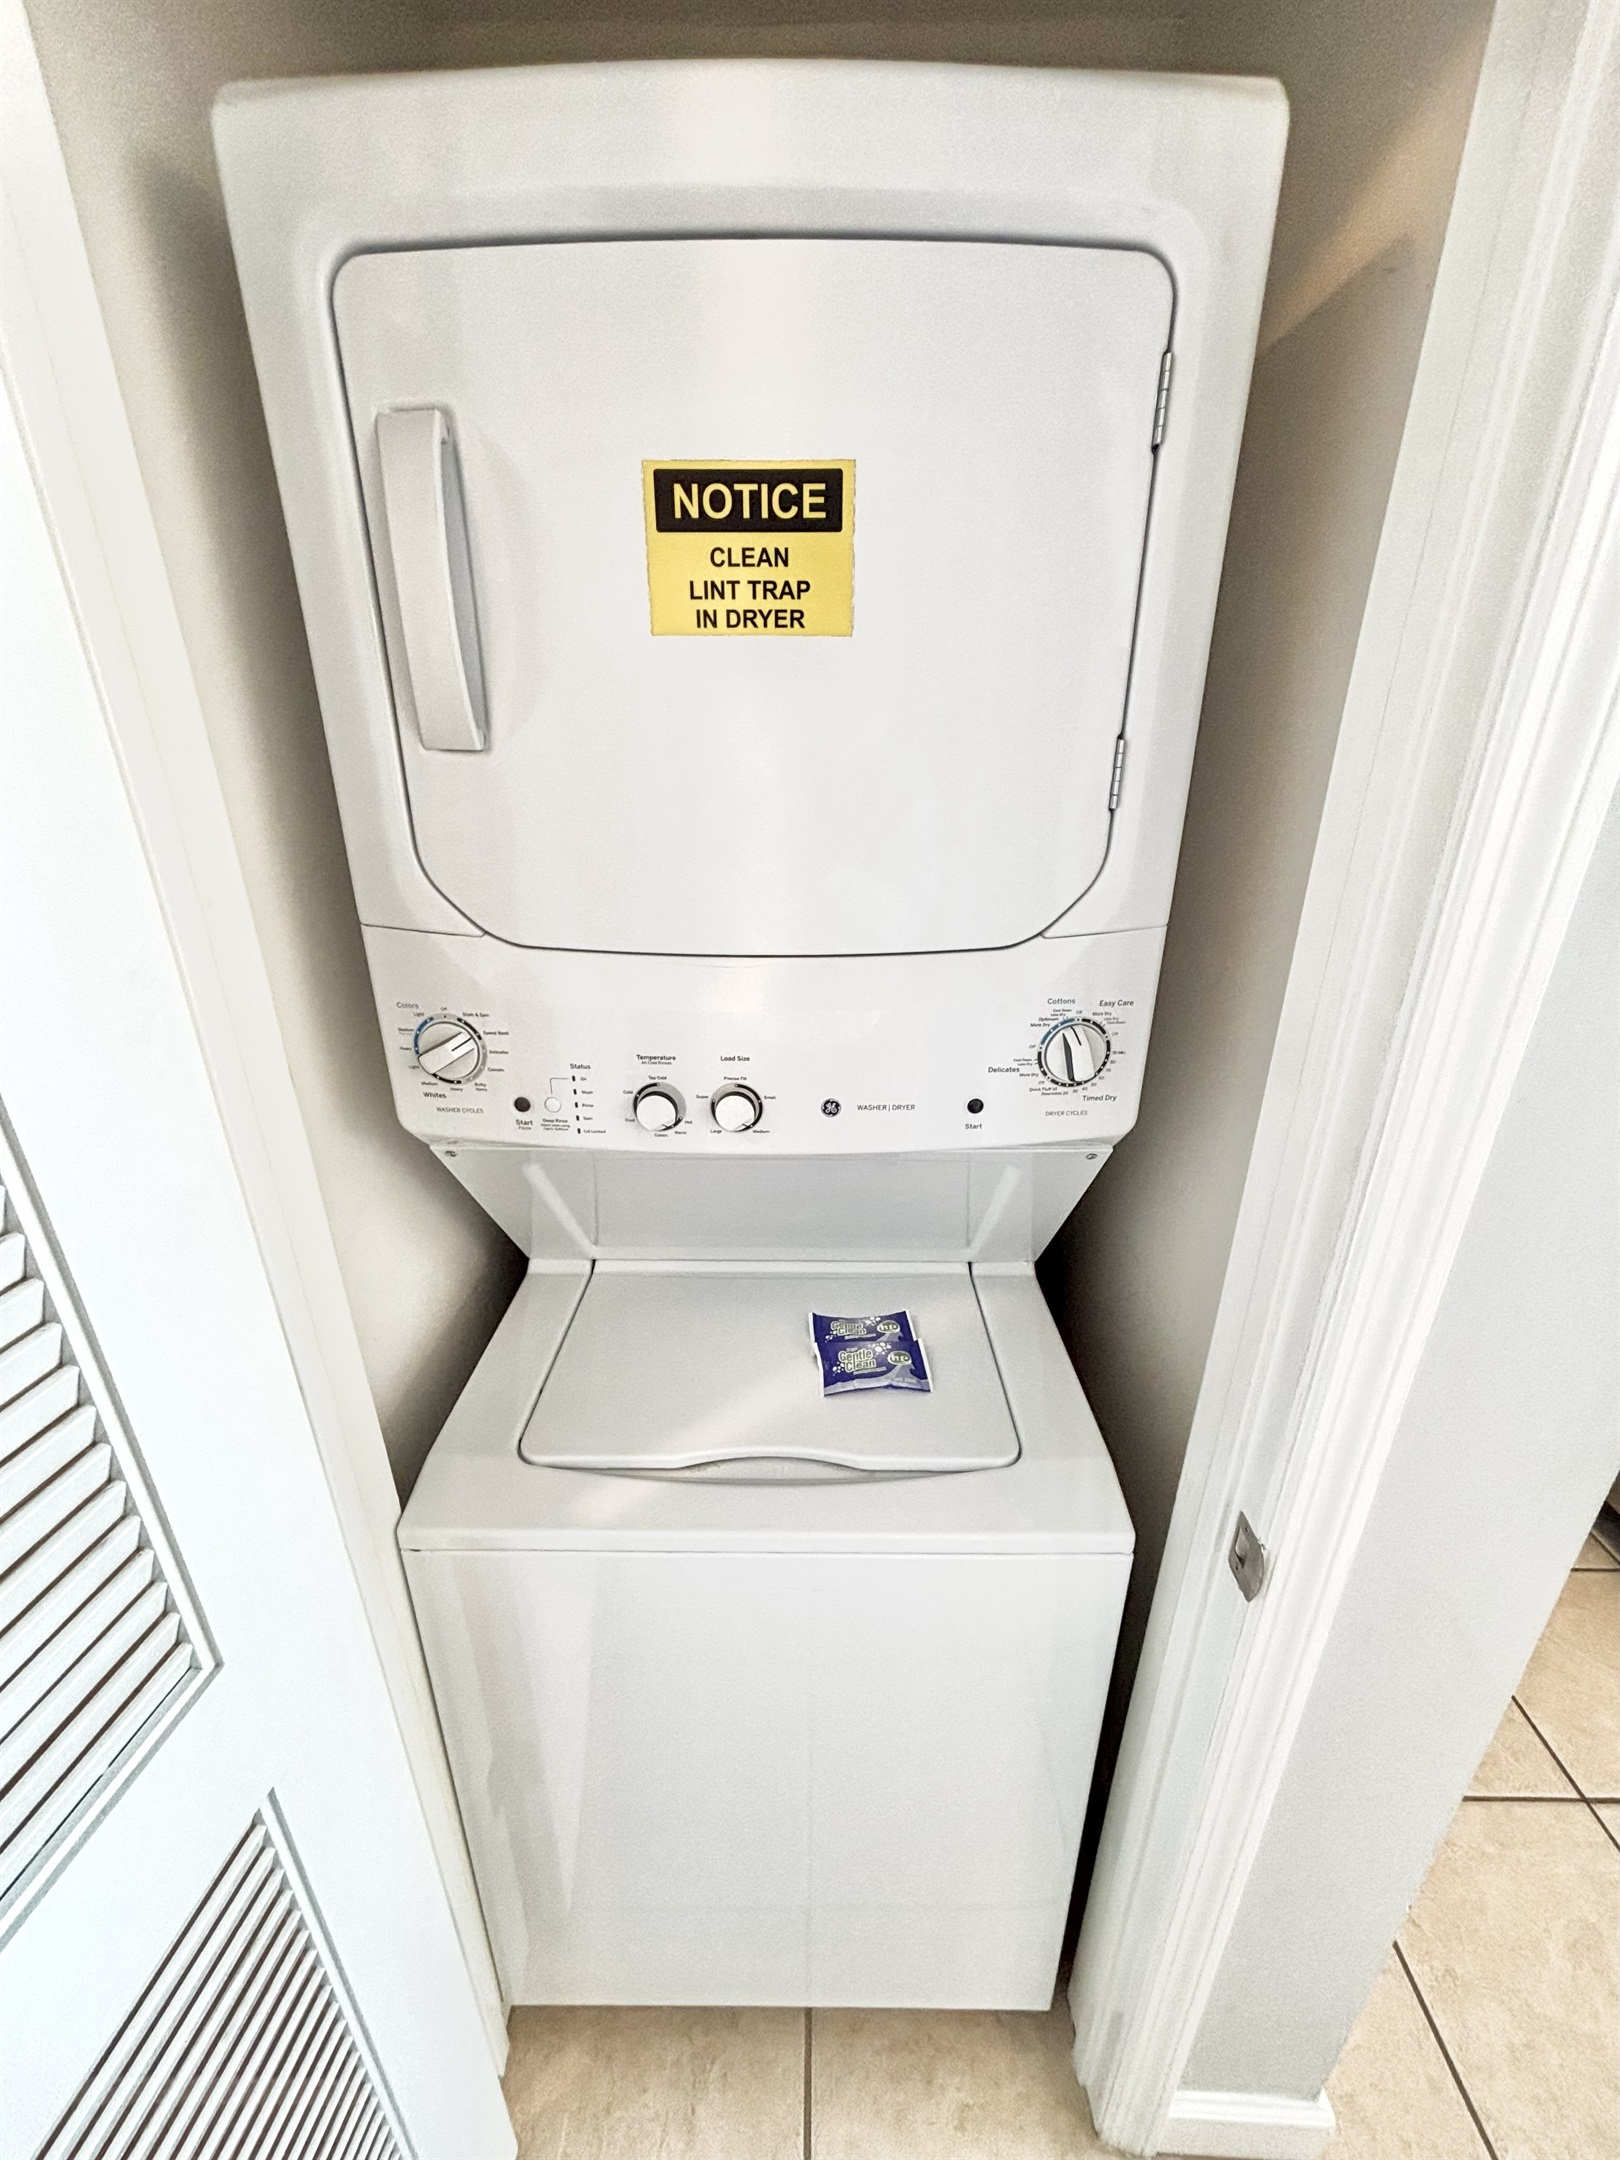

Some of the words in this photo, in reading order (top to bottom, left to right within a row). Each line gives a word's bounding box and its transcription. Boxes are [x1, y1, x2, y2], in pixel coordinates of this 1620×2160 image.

[673, 483, 827, 519] NOTICE
[710, 547, 789, 568] CLEAN
[689, 580, 740, 600] LINT
[747, 580, 811, 600] TRAP
[696, 609, 718, 628] IN
[726, 609, 806, 629] DRYER
[1099, 999, 1116, 1007] Easy
[880, 1323, 898, 1331] he
[838, 1348, 873, 1361] Gentle
[889, 1352, 909, 1362] he
[844, 1359, 877, 1373] Clean
